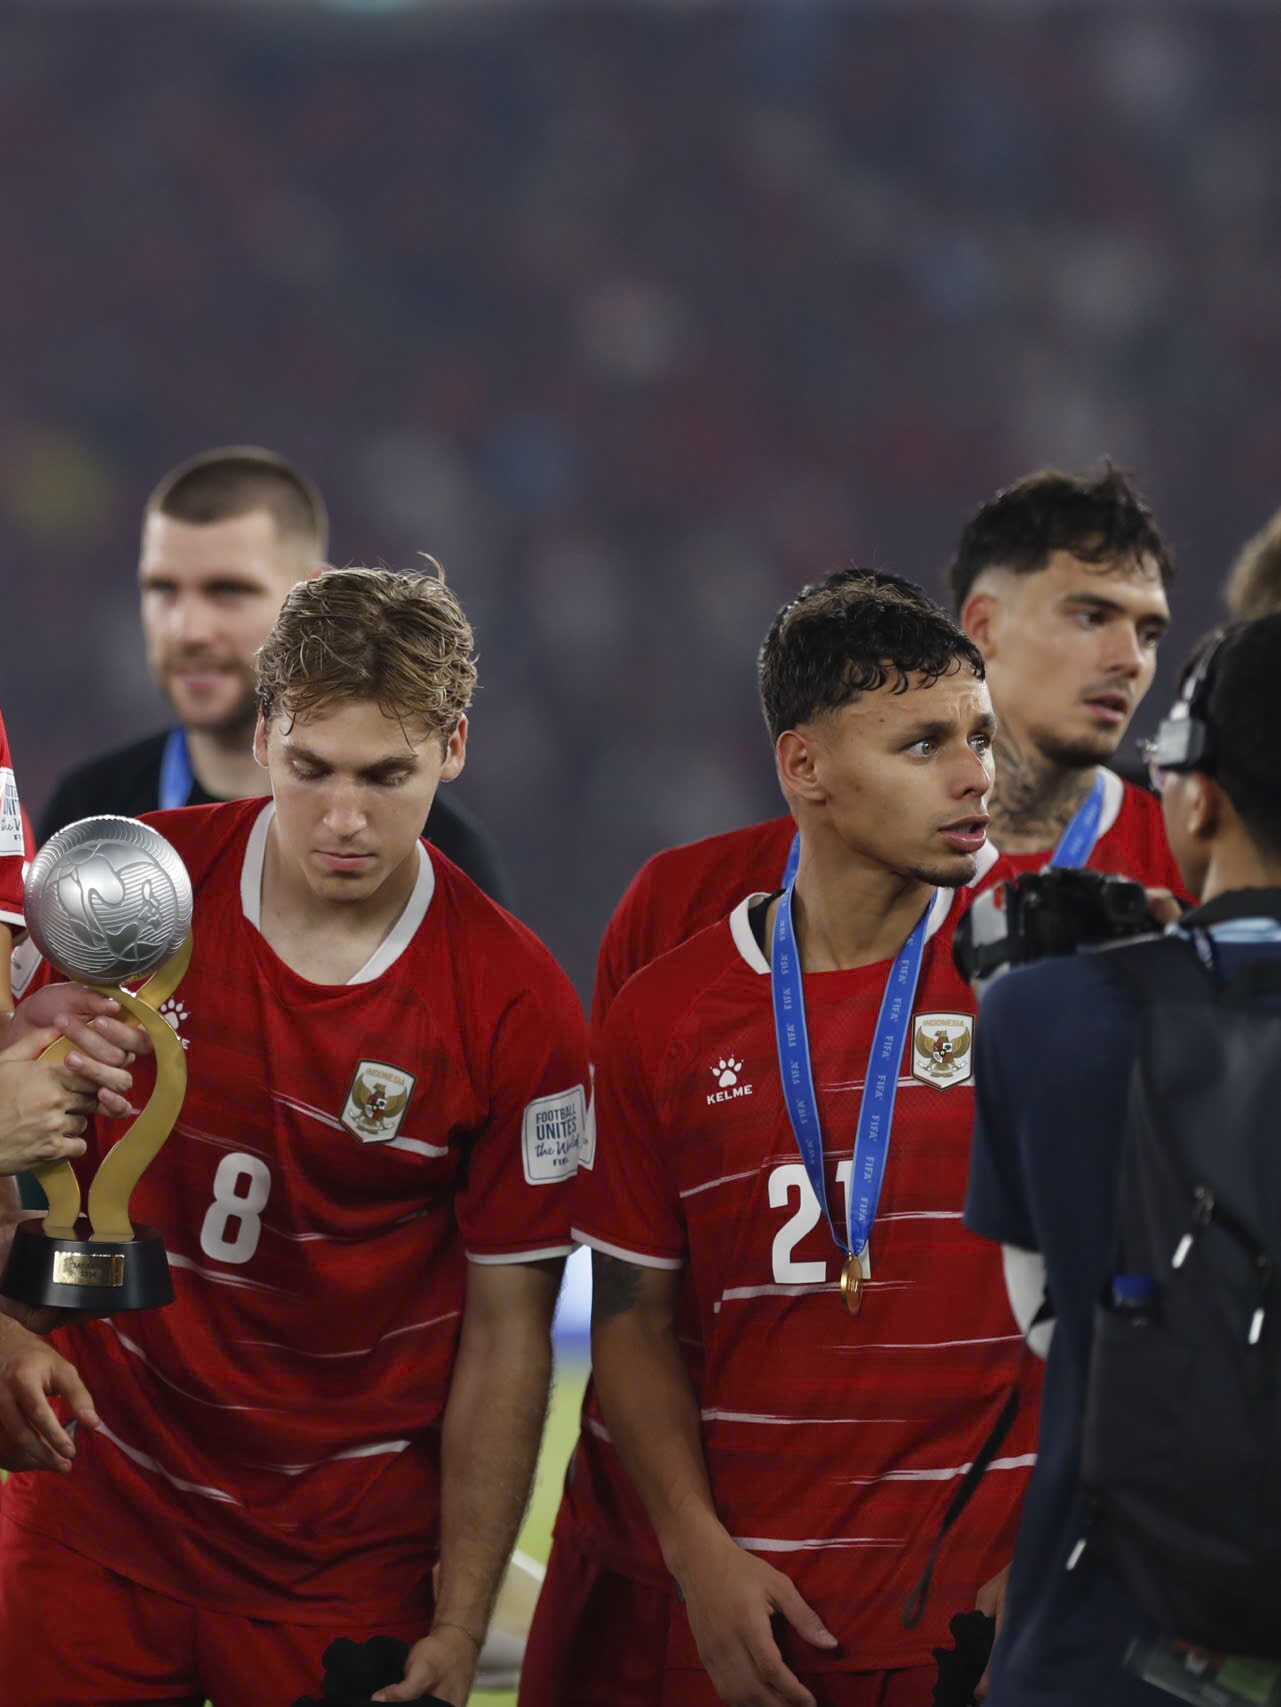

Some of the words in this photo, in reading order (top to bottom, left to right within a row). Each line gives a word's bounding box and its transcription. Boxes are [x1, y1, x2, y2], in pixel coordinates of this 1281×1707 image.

[899, 959, 910, 985] FIFA
[784, 986, 793, 1010] FIFA
[890, 997, 903, 1022] FIFA
[786, 1023, 797, 1047] FIFA
[881, 1035, 894, 1061] FIFA
[791, 1060, 801, 1085] FIFA
[706, 1084, 753, 1105] KELME
[875, 1074, 887, 1101] FIFA
[536, 1104, 576, 1124] FOOTBALL
[796, 1098, 808, 1125] FIFA
[536, 1117, 577, 1140] UNITES
[869, 1115, 881, 1142] FIFA
[534, 1141, 555, 1158] the
[863, 1156, 875, 1183] FIFA
[200, 1152, 271, 1264] 8
[859, 1197, 869, 1223] FIFA
